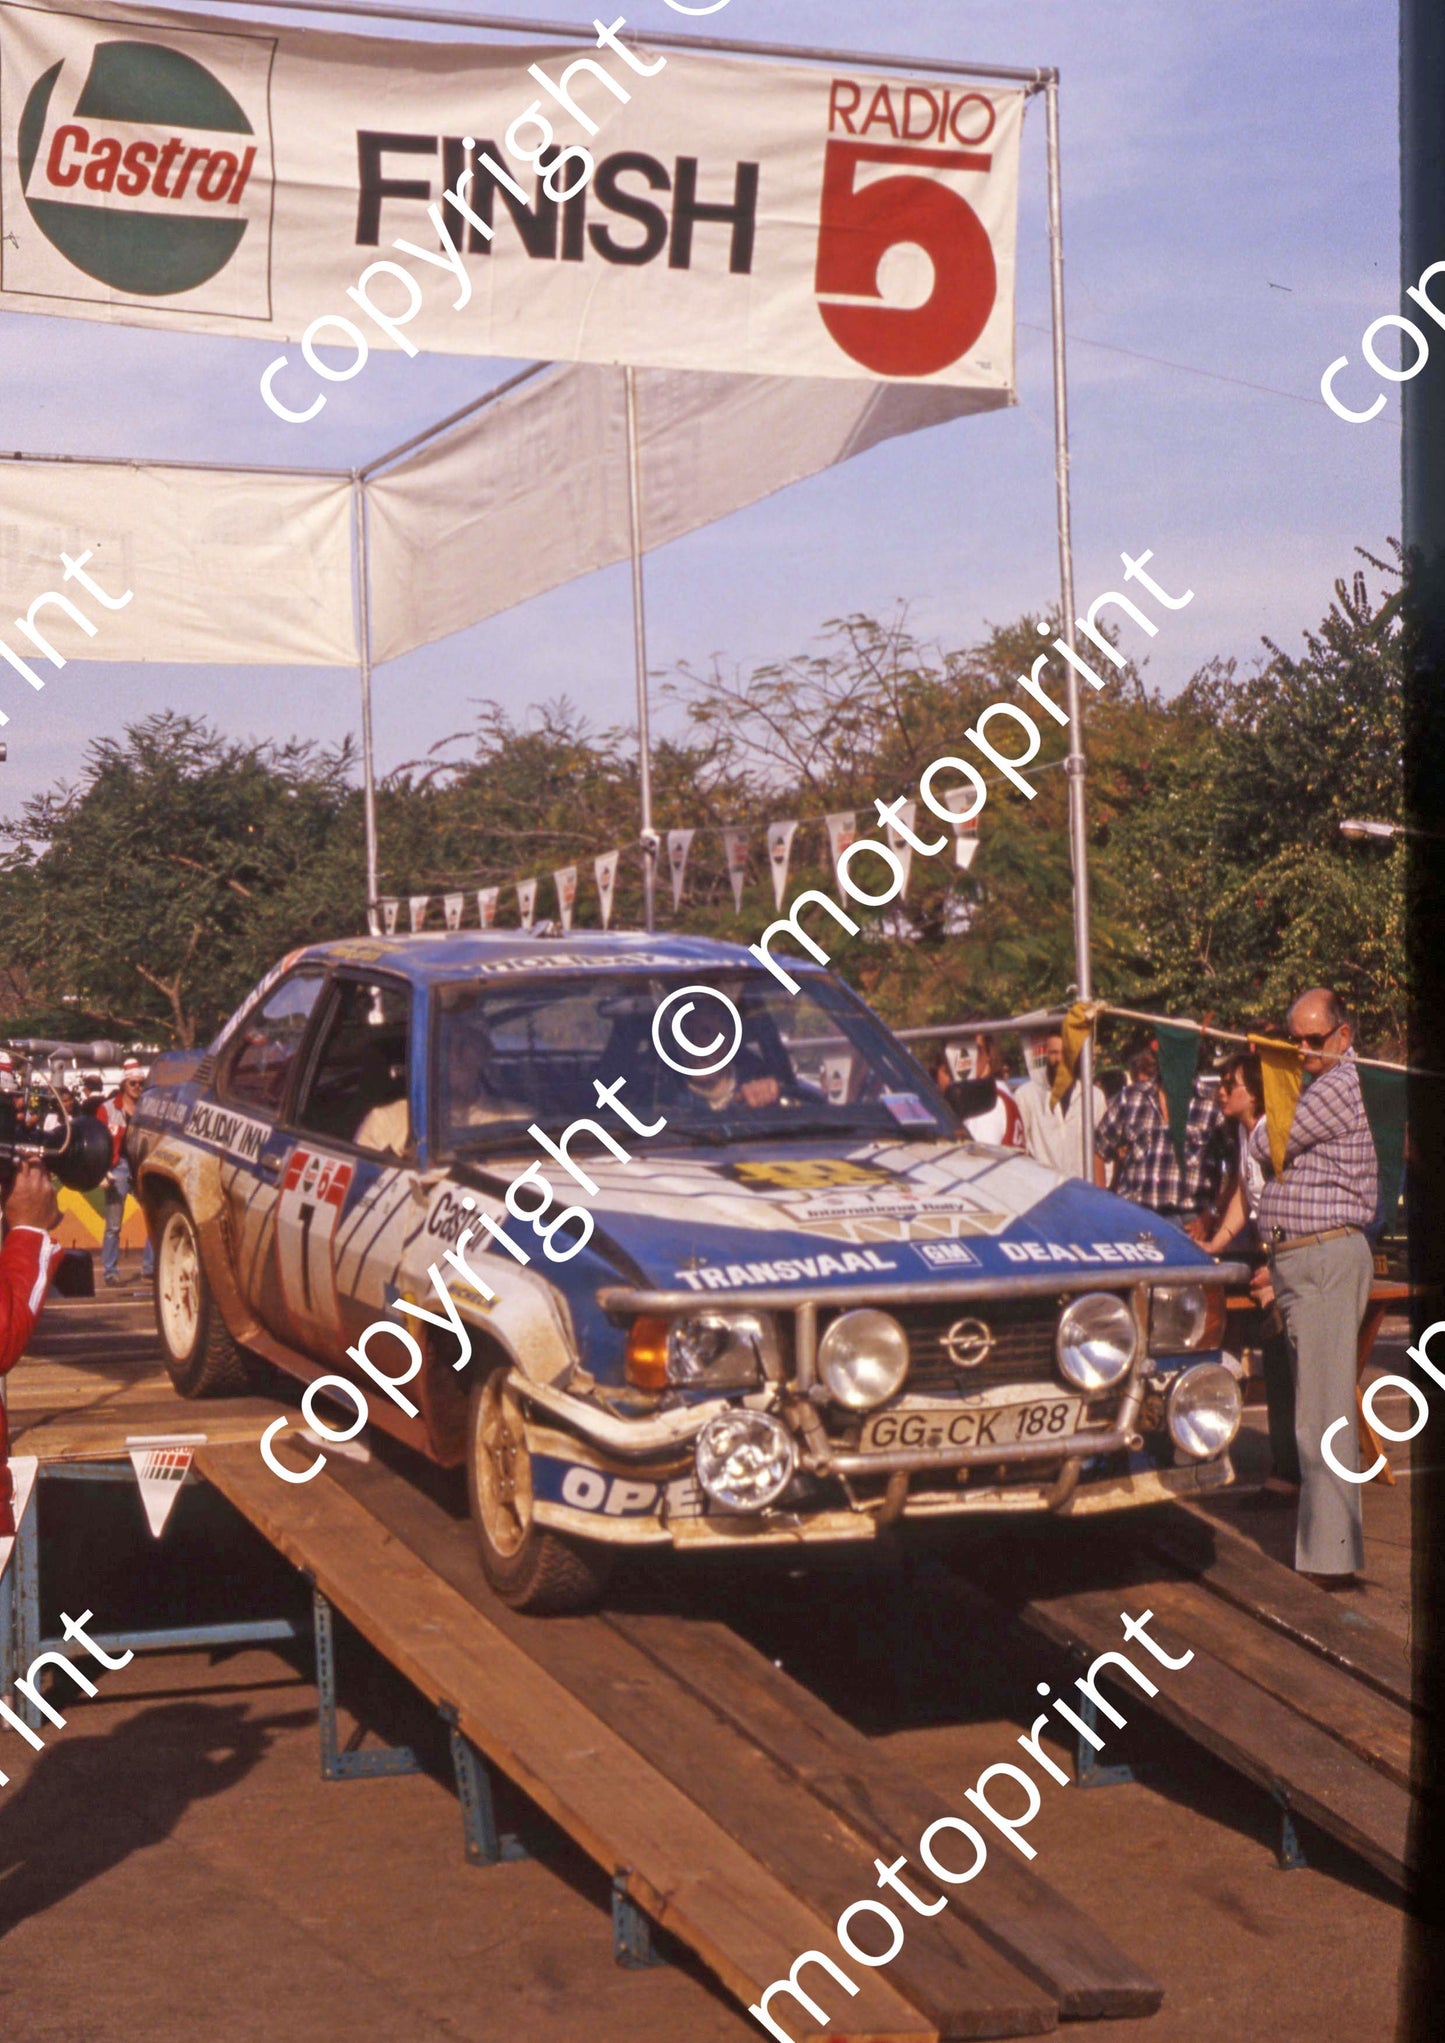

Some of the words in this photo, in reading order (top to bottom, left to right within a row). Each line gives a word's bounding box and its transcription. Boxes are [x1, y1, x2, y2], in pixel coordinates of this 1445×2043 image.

[827, 78, 995, 146] RADIO
[46, 124, 257, 204] Castrol
[355, 129, 759, 275] FINISH
[815, 138, 997, 377] 5
[237, 1123, 268, 1159] INN
[806, 1202, 917, 1219] International
[675, 1249, 897, 1291] TRANSVAAL
[922, 1243, 966, 1264] GM
[999, 1242, 1165, 1263] DEALERS
[1016, 1403, 1069, 1437] 188
[562, 1466, 722, 1517] OPE
